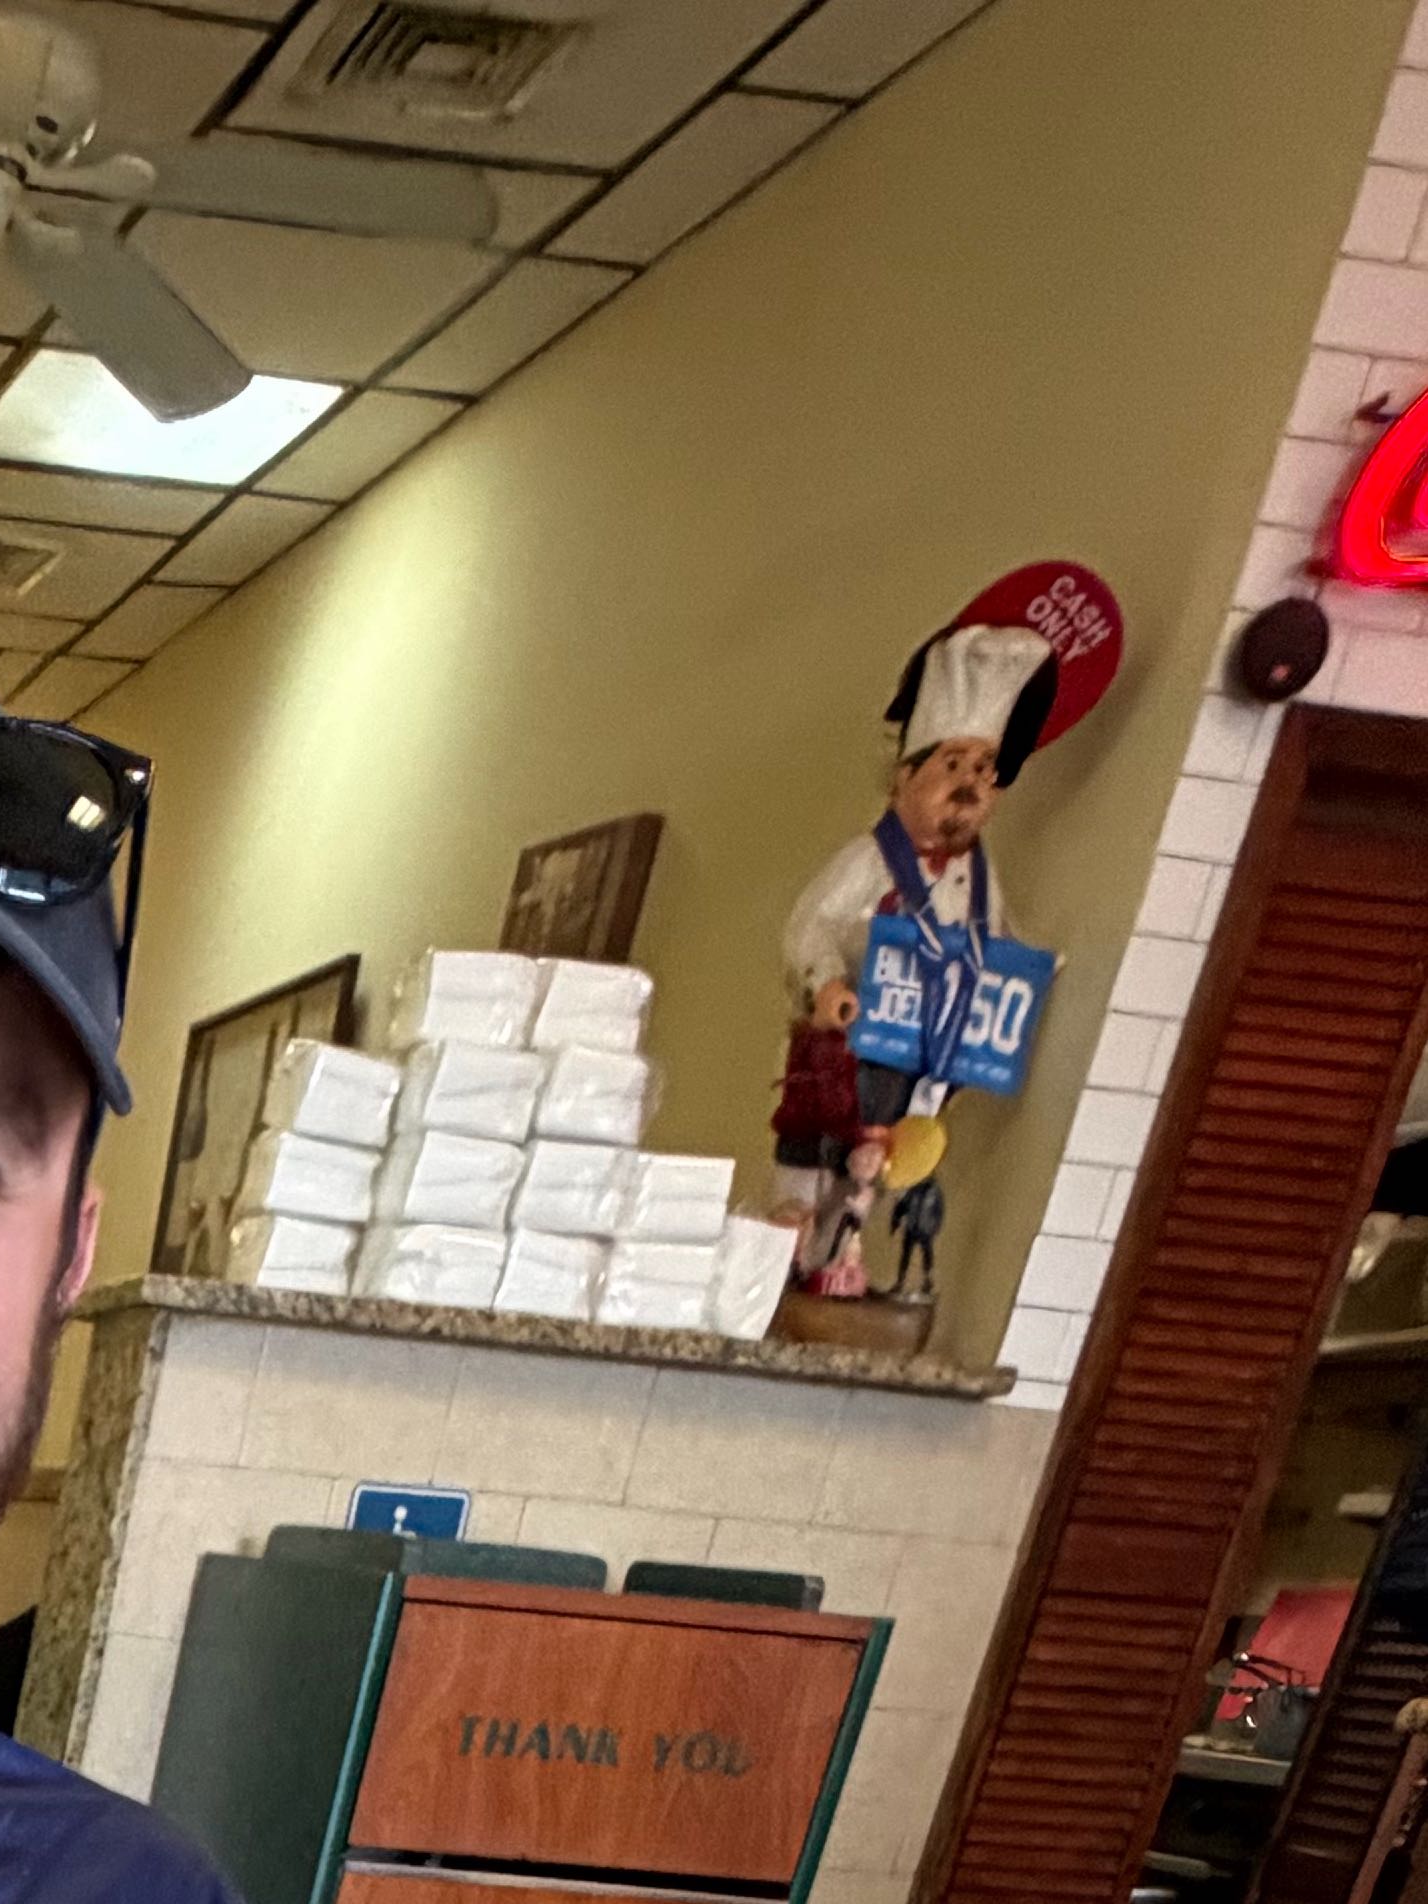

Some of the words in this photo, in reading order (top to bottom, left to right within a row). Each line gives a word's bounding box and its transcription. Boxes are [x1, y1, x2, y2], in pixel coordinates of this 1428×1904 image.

[1026, 595, 1089, 661] ONLY
[1050, 575, 1113, 648] CASH
[873, 945, 923, 987] BILL
[457, 1714, 619, 1767] THANK
